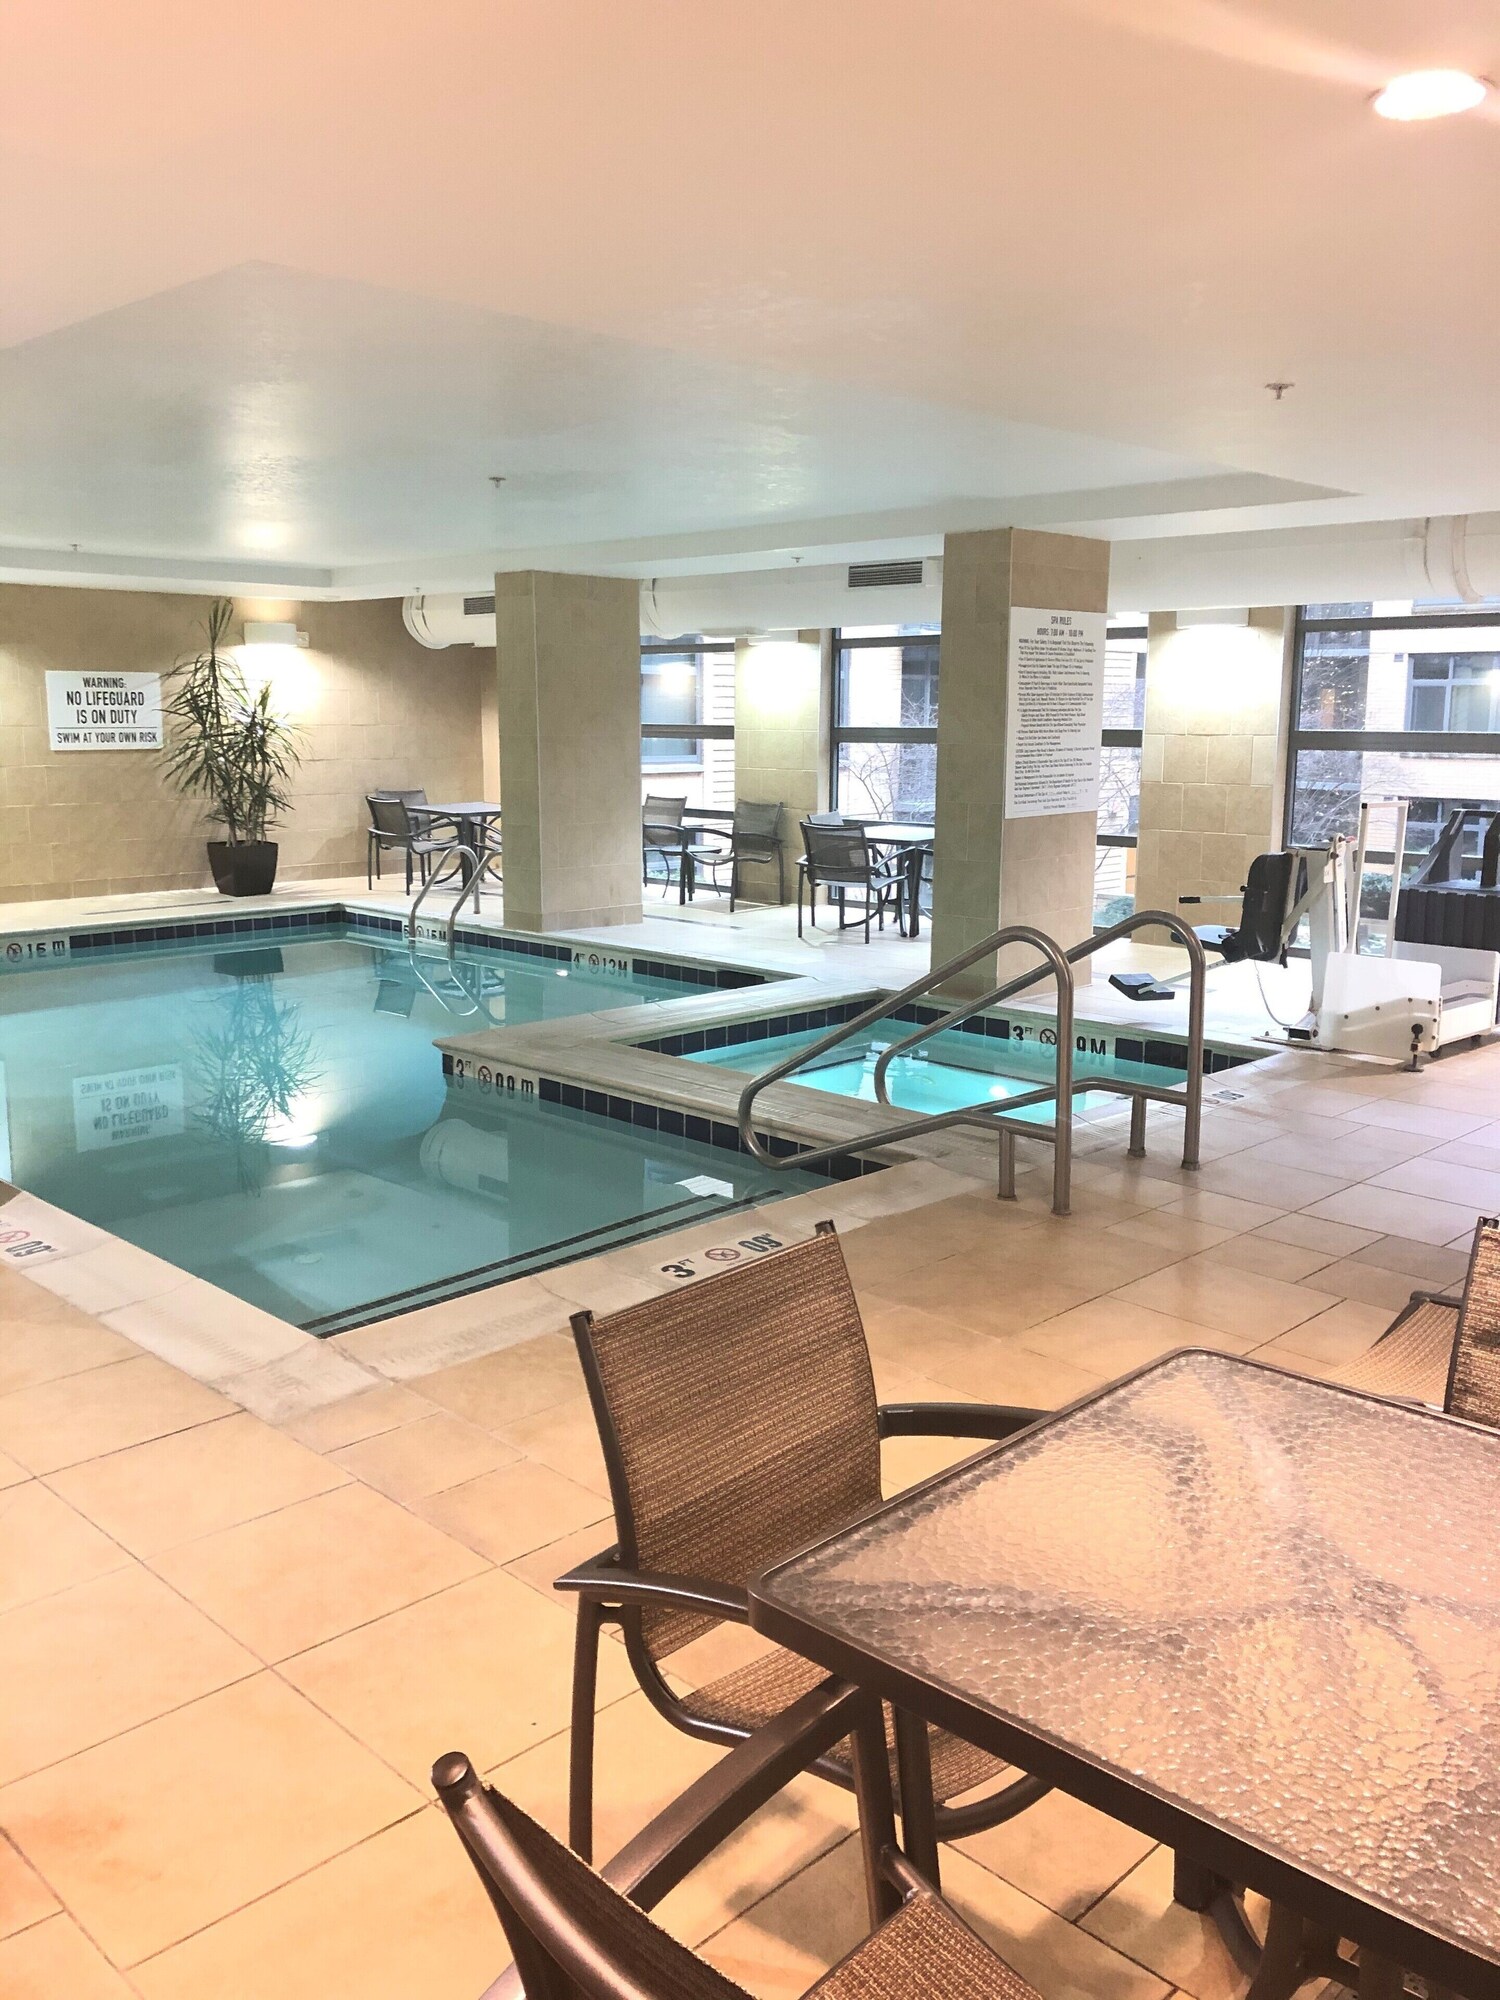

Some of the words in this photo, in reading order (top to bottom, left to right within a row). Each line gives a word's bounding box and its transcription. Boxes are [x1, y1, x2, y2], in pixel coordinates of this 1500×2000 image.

[82, 677, 127, 689] WARNING:
[66, 691, 82, 706] NO
[85, 691, 145, 706] LIFEGUARD
[76, 709, 87, 724] IS
[91, 709, 106, 724] ON
[110, 709, 138, 724] DUTY
[57, 732, 81, 743] SWIM
[83, 732, 92, 743] AT
[95, 732, 116, 743] YOUR
[119, 732, 137, 743] OWN
[139, 732, 157, 743] RISK
